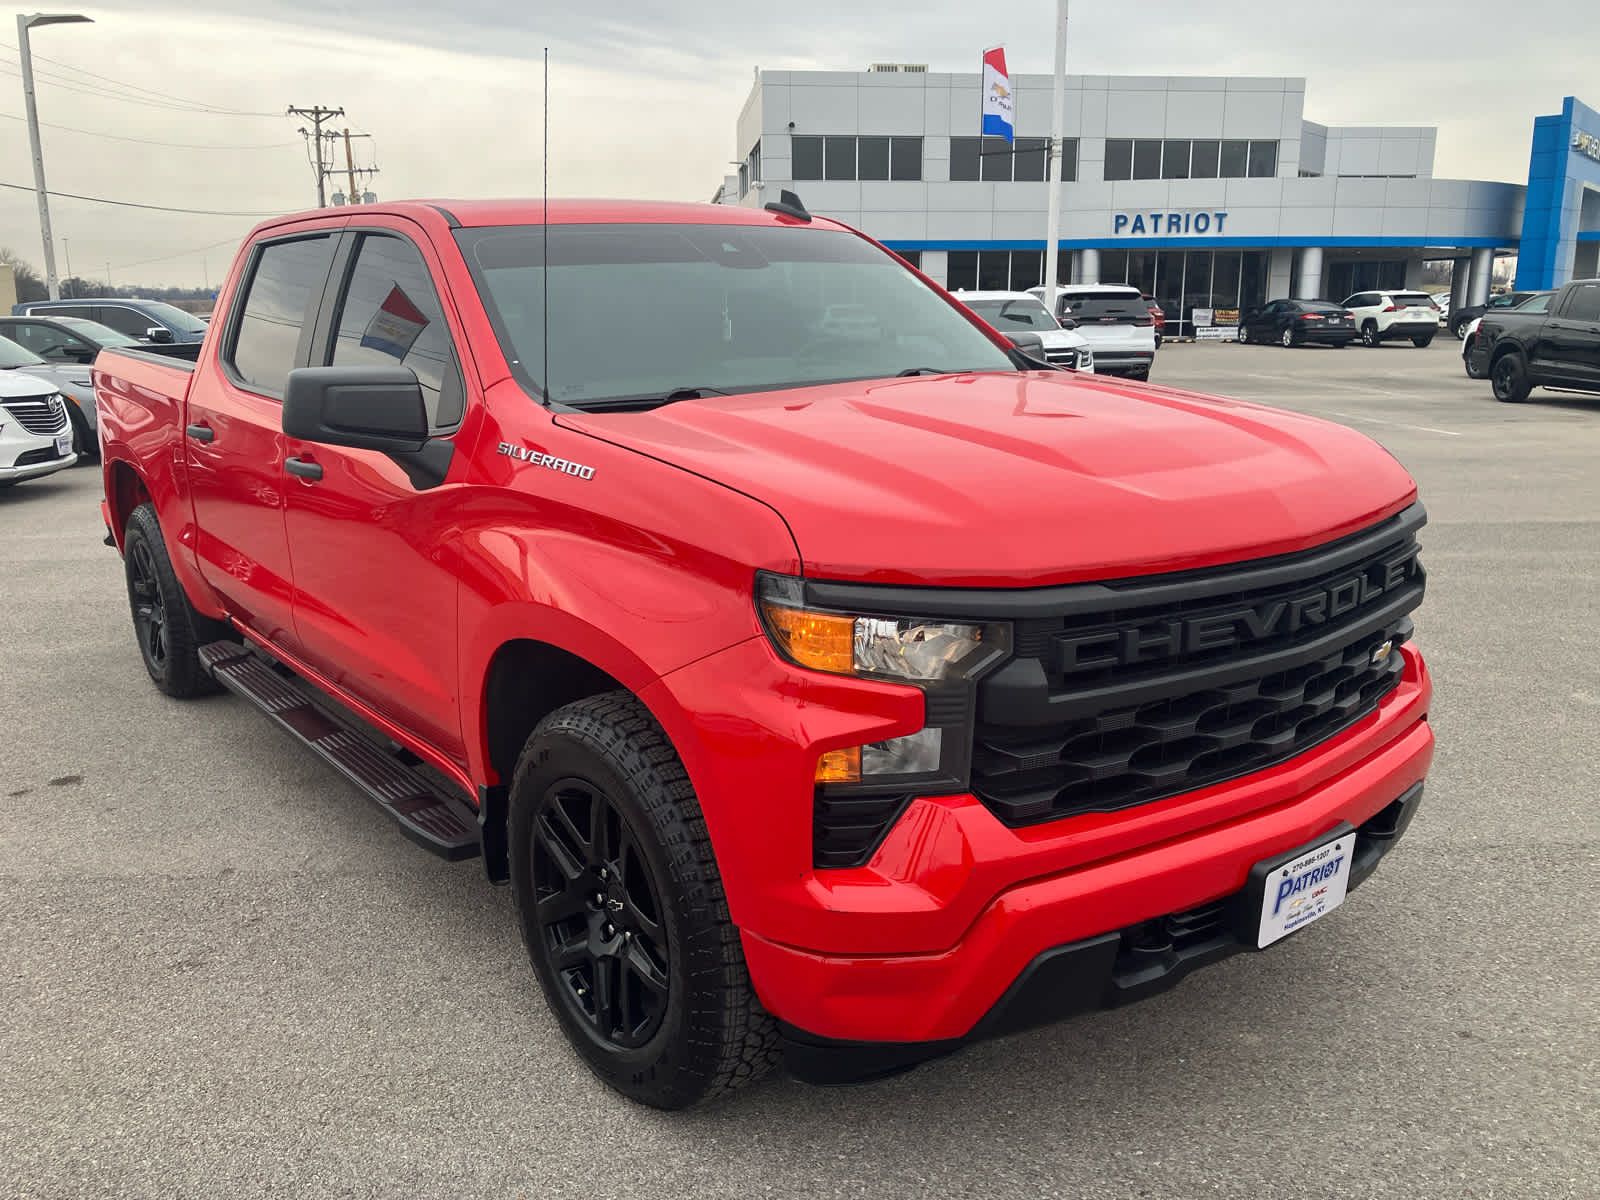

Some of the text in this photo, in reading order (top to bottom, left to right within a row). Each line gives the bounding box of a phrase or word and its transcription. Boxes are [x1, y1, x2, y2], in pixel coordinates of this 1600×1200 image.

[1114, 212, 1228, 234] PATRIOT
[497, 441, 595, 480] SILVERADO
[1273, 855, 1344, 915] PATRIOT
[1311, 886, 1328, 899] GMC
